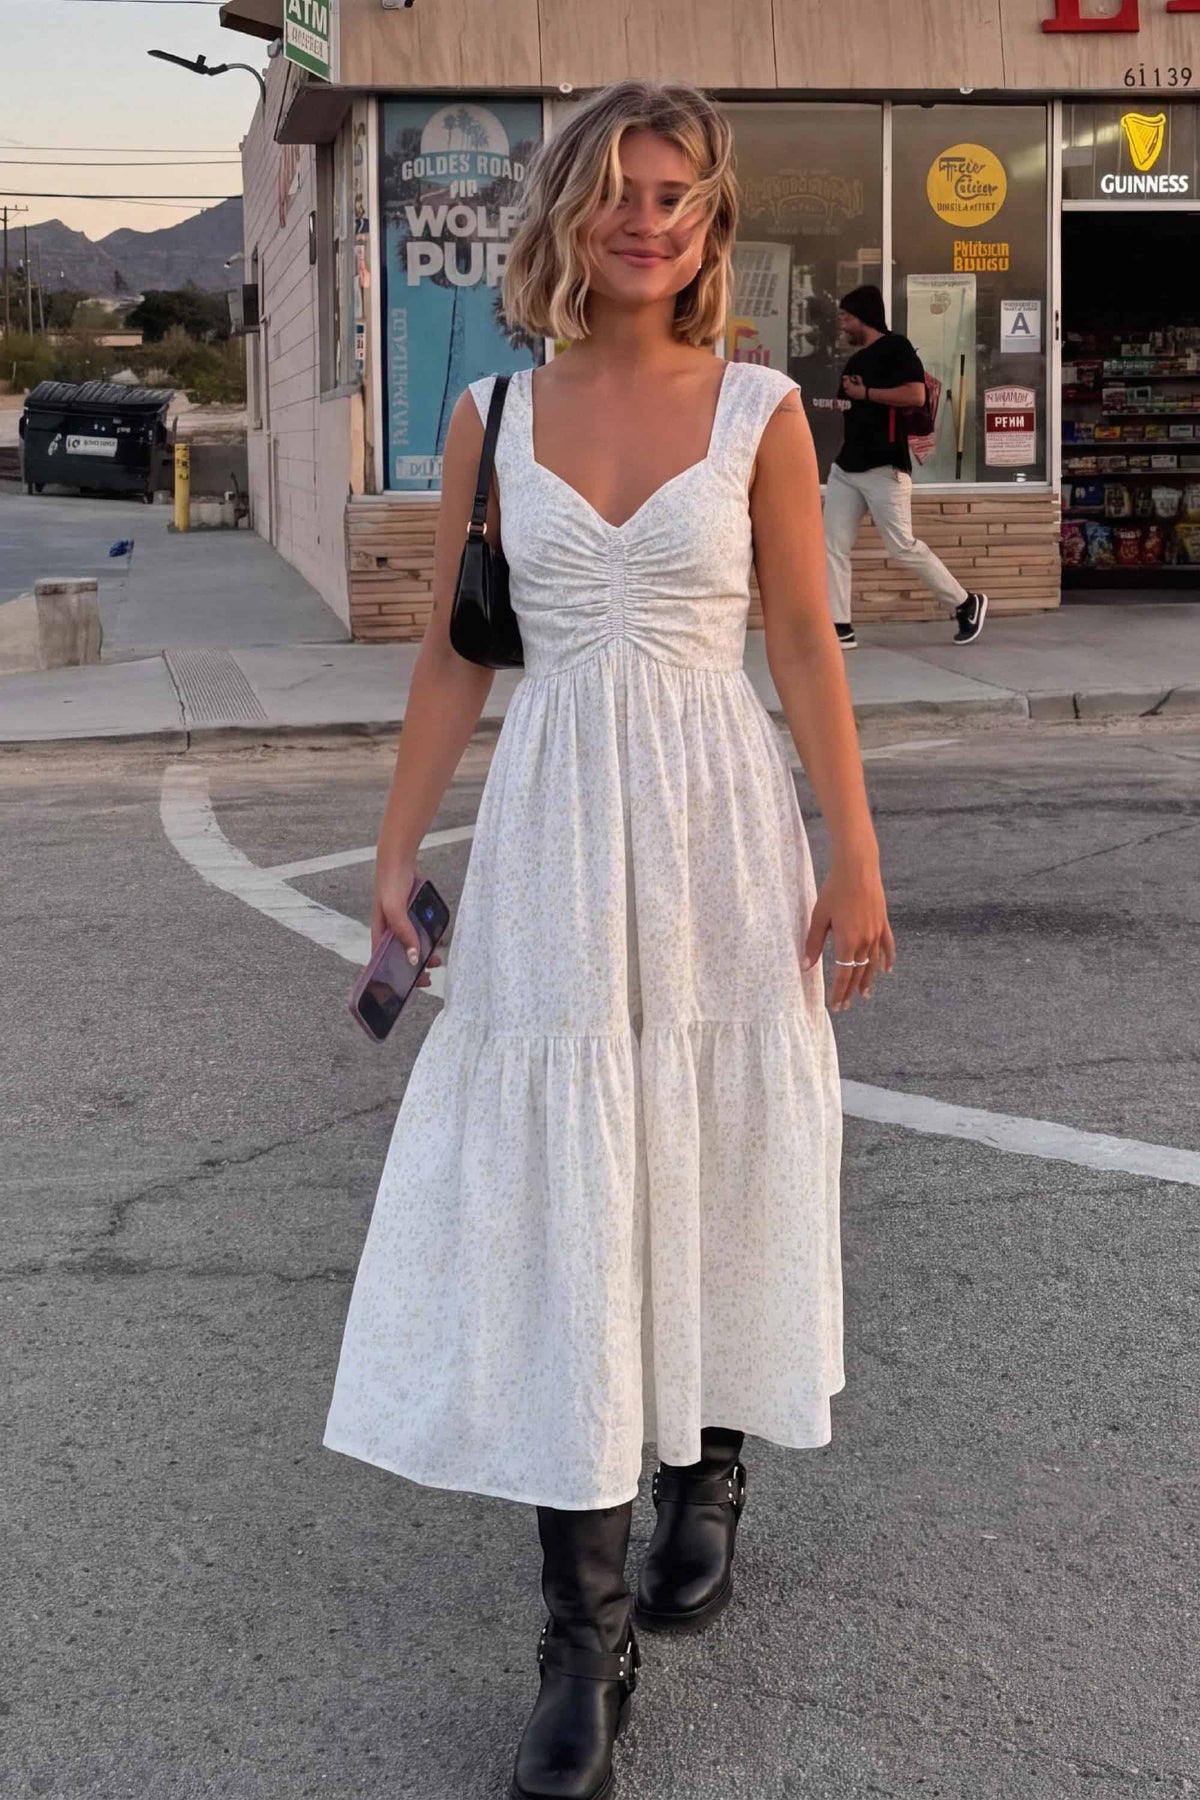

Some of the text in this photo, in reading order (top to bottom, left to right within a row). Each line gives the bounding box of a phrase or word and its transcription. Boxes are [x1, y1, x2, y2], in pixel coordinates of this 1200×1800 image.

[288, 0, 327, 35] ATM
[1124, 66, 1193, 87] 61139
[477, 155, 524, 182] ROAD
[1101, 174, 1189, 193] GUINNESS
[404, 205, 523, 238] WOLF
[1010, 312, 1031, 335] A
